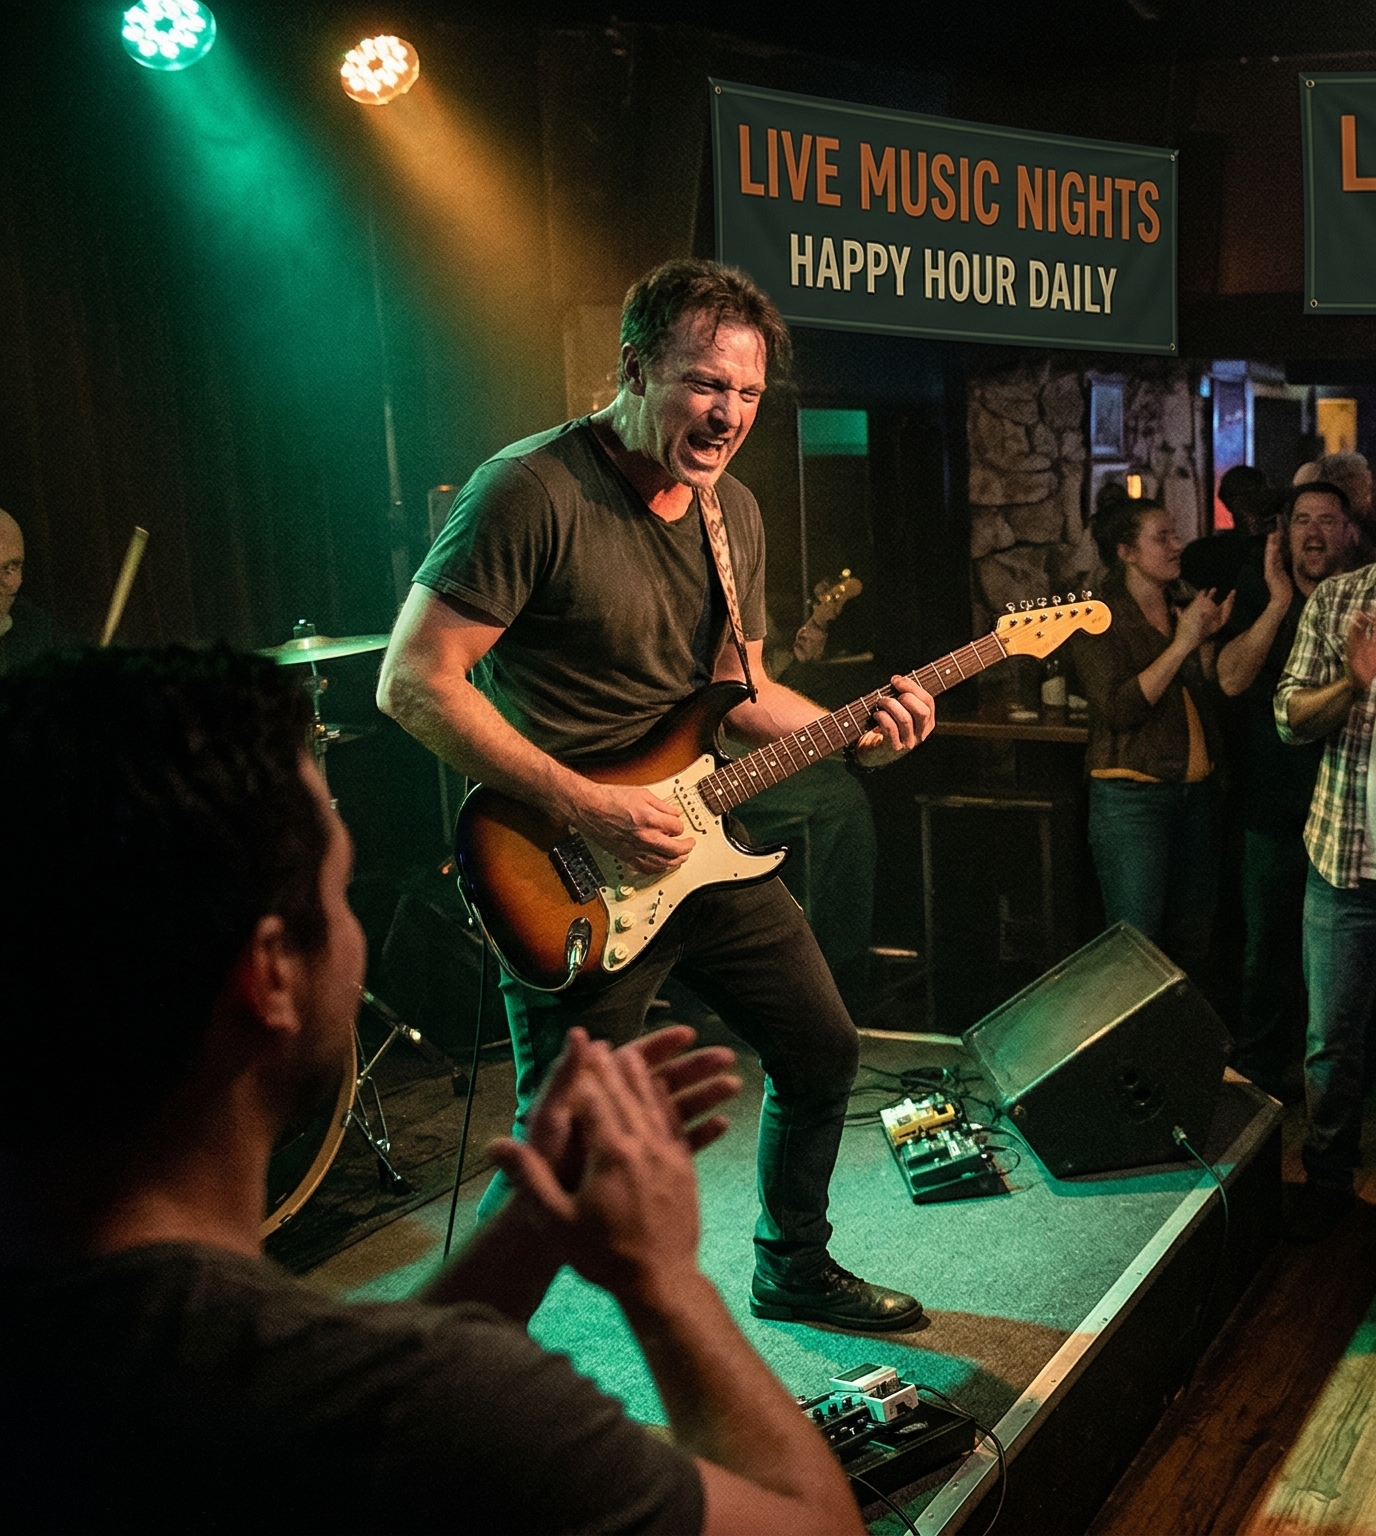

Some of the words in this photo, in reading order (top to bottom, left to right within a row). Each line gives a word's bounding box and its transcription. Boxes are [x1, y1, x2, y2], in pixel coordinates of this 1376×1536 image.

[738, 124, 842, 207] LIVE
[859, 142, 1001, 227] MUSIC
[1016, 164, 1161, 244] NIGHTS
[790, 233, 912, 297] HAPPY
[923, 248, 1018, 307] HOUR
[1028, 260, 1118, 315] DAILY
